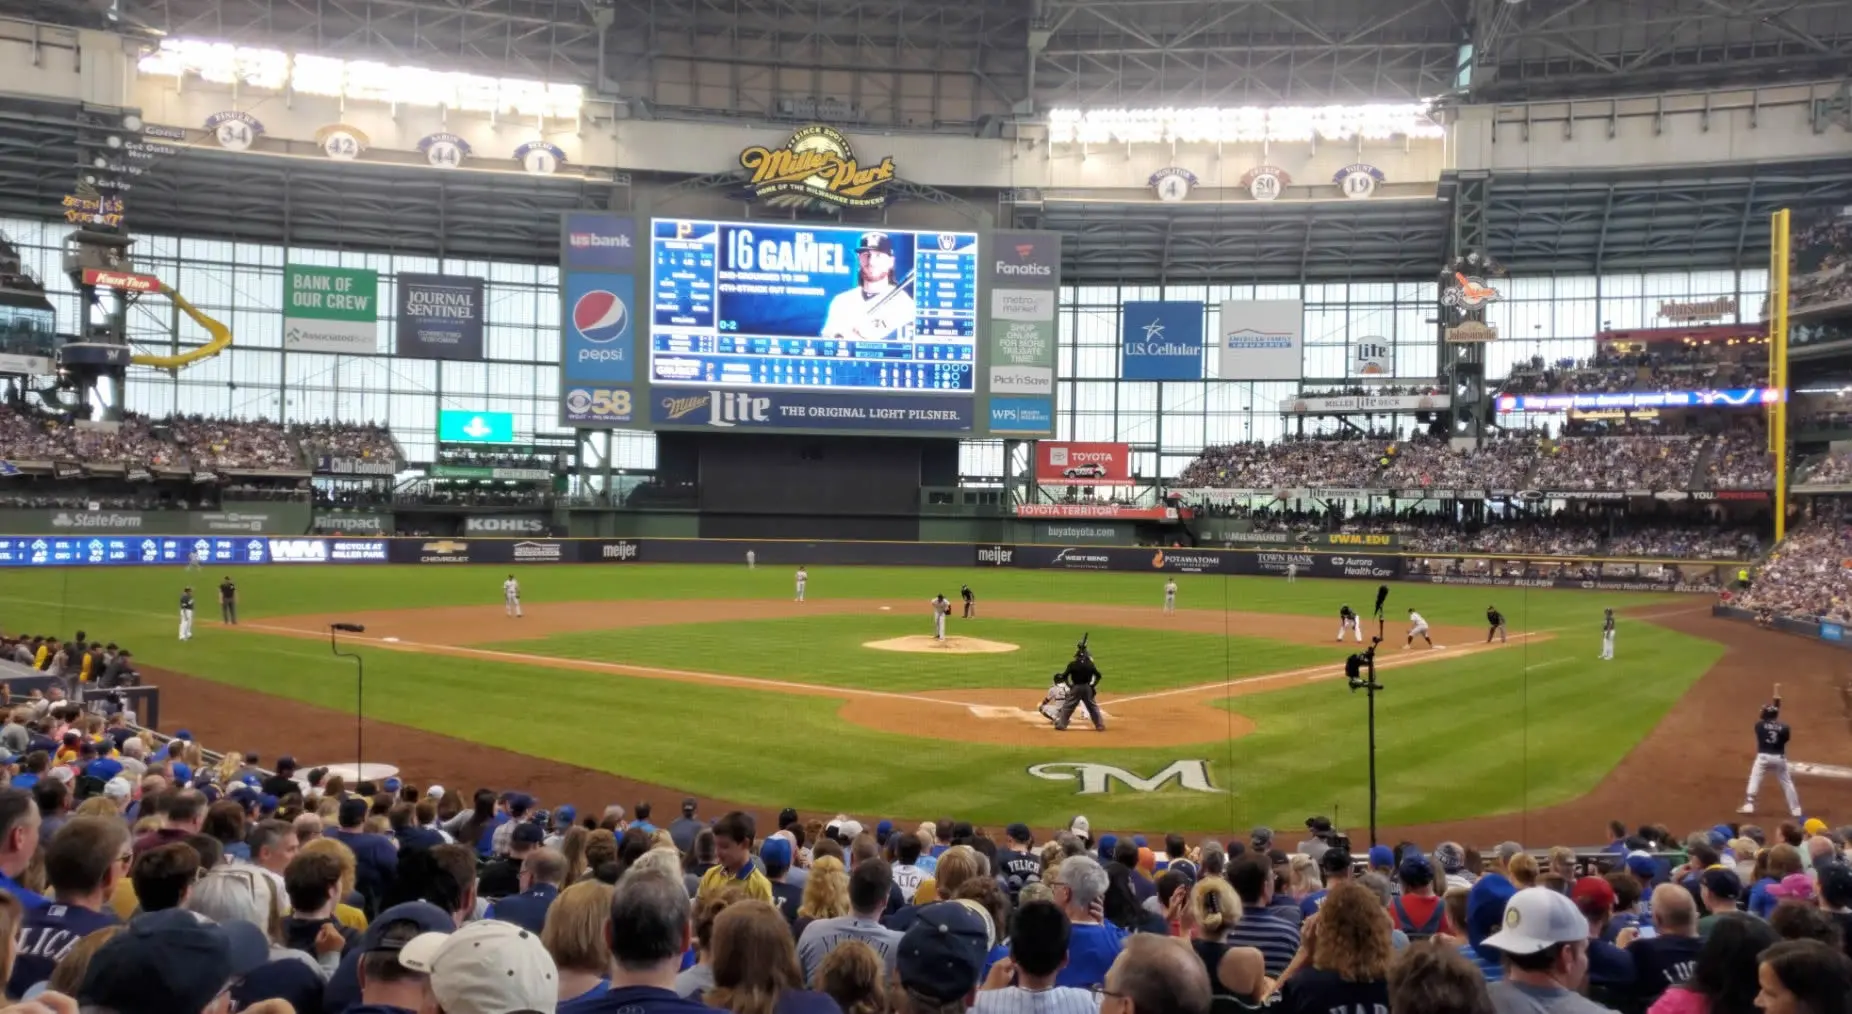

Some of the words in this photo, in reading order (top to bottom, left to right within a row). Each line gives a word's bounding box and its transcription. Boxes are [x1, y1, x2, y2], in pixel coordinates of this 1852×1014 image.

[221, 126, 248, 143] 34
[795, 127, 821, 141] SINCE
[329, 138, 354, 153] 42
[740, 147, 838, 184] Miller
[817, 156, 896, 196] Park
[1350, 177, 1369, 192] 19
[756, 185, 777, 196] HOME
[790, 183, 805, 192] THE
[806, 185, 848, 203] MILWAUKEE
[849, 196, 885, 206] BREWERS
[728, 229, 753, 270] 16
[759, 239, 850, 275] GAMEL
[996, 260, 1051, 276] Fanatics
[293, 274, 331, 290] BANK
[335, 277, 353, 292] OF
[293, 291, 322, 308] OUR
[326, 294, 368, 311] CREW
[409, 290, 474, 307] JOURNAL
[407, 303, 474, 318] SENTINEL
[1656, 297, 1736, 317] Johnsonville
[720, 320, 736, 330] 0-2
[1010, 323, 1035, 332] SHOP
[1006, 331, 1039, 340] ONLINE
[1447, 329, 1496, 341] Johnsonville
[999, 338, 1018, 347] FOR
[1019, 339, 1046, 348] MORE
[1126, 342, 1146, 355] U.S.
[1148, 342, 1201, 356] Cellular
[578, 347, 623, 363] pepsi
[1359, 343, 1386, 361] Lite
[994, 374, 1014, 384] Pick
[1024, 376, 1049, 386] Save
[591, 390, 632, 415] 58
[662, 396, 709, 419] Miller
[708, 391, 771, 427] Lite
[780, 405, 806, 417] THE
[808, 406, 866, 418] ORIGINAL
[869, 407, 904, 419] LIGHT
[908, 408, 960, 421] PILSNER.
[992, 409, 1017, 420] WPS
[1072, 452, 1113, 461] TOYOTA
[331, 458, 354, 474] Club
[355, 459, 396, 475] Goodwill
[1019, 505, 1060, 516] TOYOTA
[1062, 505, 1120, 517] TERRITORY
[467, 517, 543, 531] KOHL'S
[1048, 525, 1115, 538] buyatoyota.com
[335, 542, 371, 551] RECYCLE
[371, 543, 383, 551] AT
[1328, 534, 1390, 545] UWM.EDU
[332, 550, 361, 559] MILLER
[362, 551, 385, 560] PARK
[603, 540, 637, 561] meijer
[977, 545, 1013, 565] meijer
[1164, 556, 1220, 565] POTAWATOMI
[1257, 553, 1285, 562] TOWN
[1287, 555, 1315, 565] BANK
[1345, 558, 1373, 567] Aurora
[1344, 566, 1371, 577] Health
[1372, 567, 1392, 577] Care
[1514, 579, 1553, 588] BULLPEN
[1765, 731, 1778, 744] 3
[1007, 859, 1041, 874] YELICH
